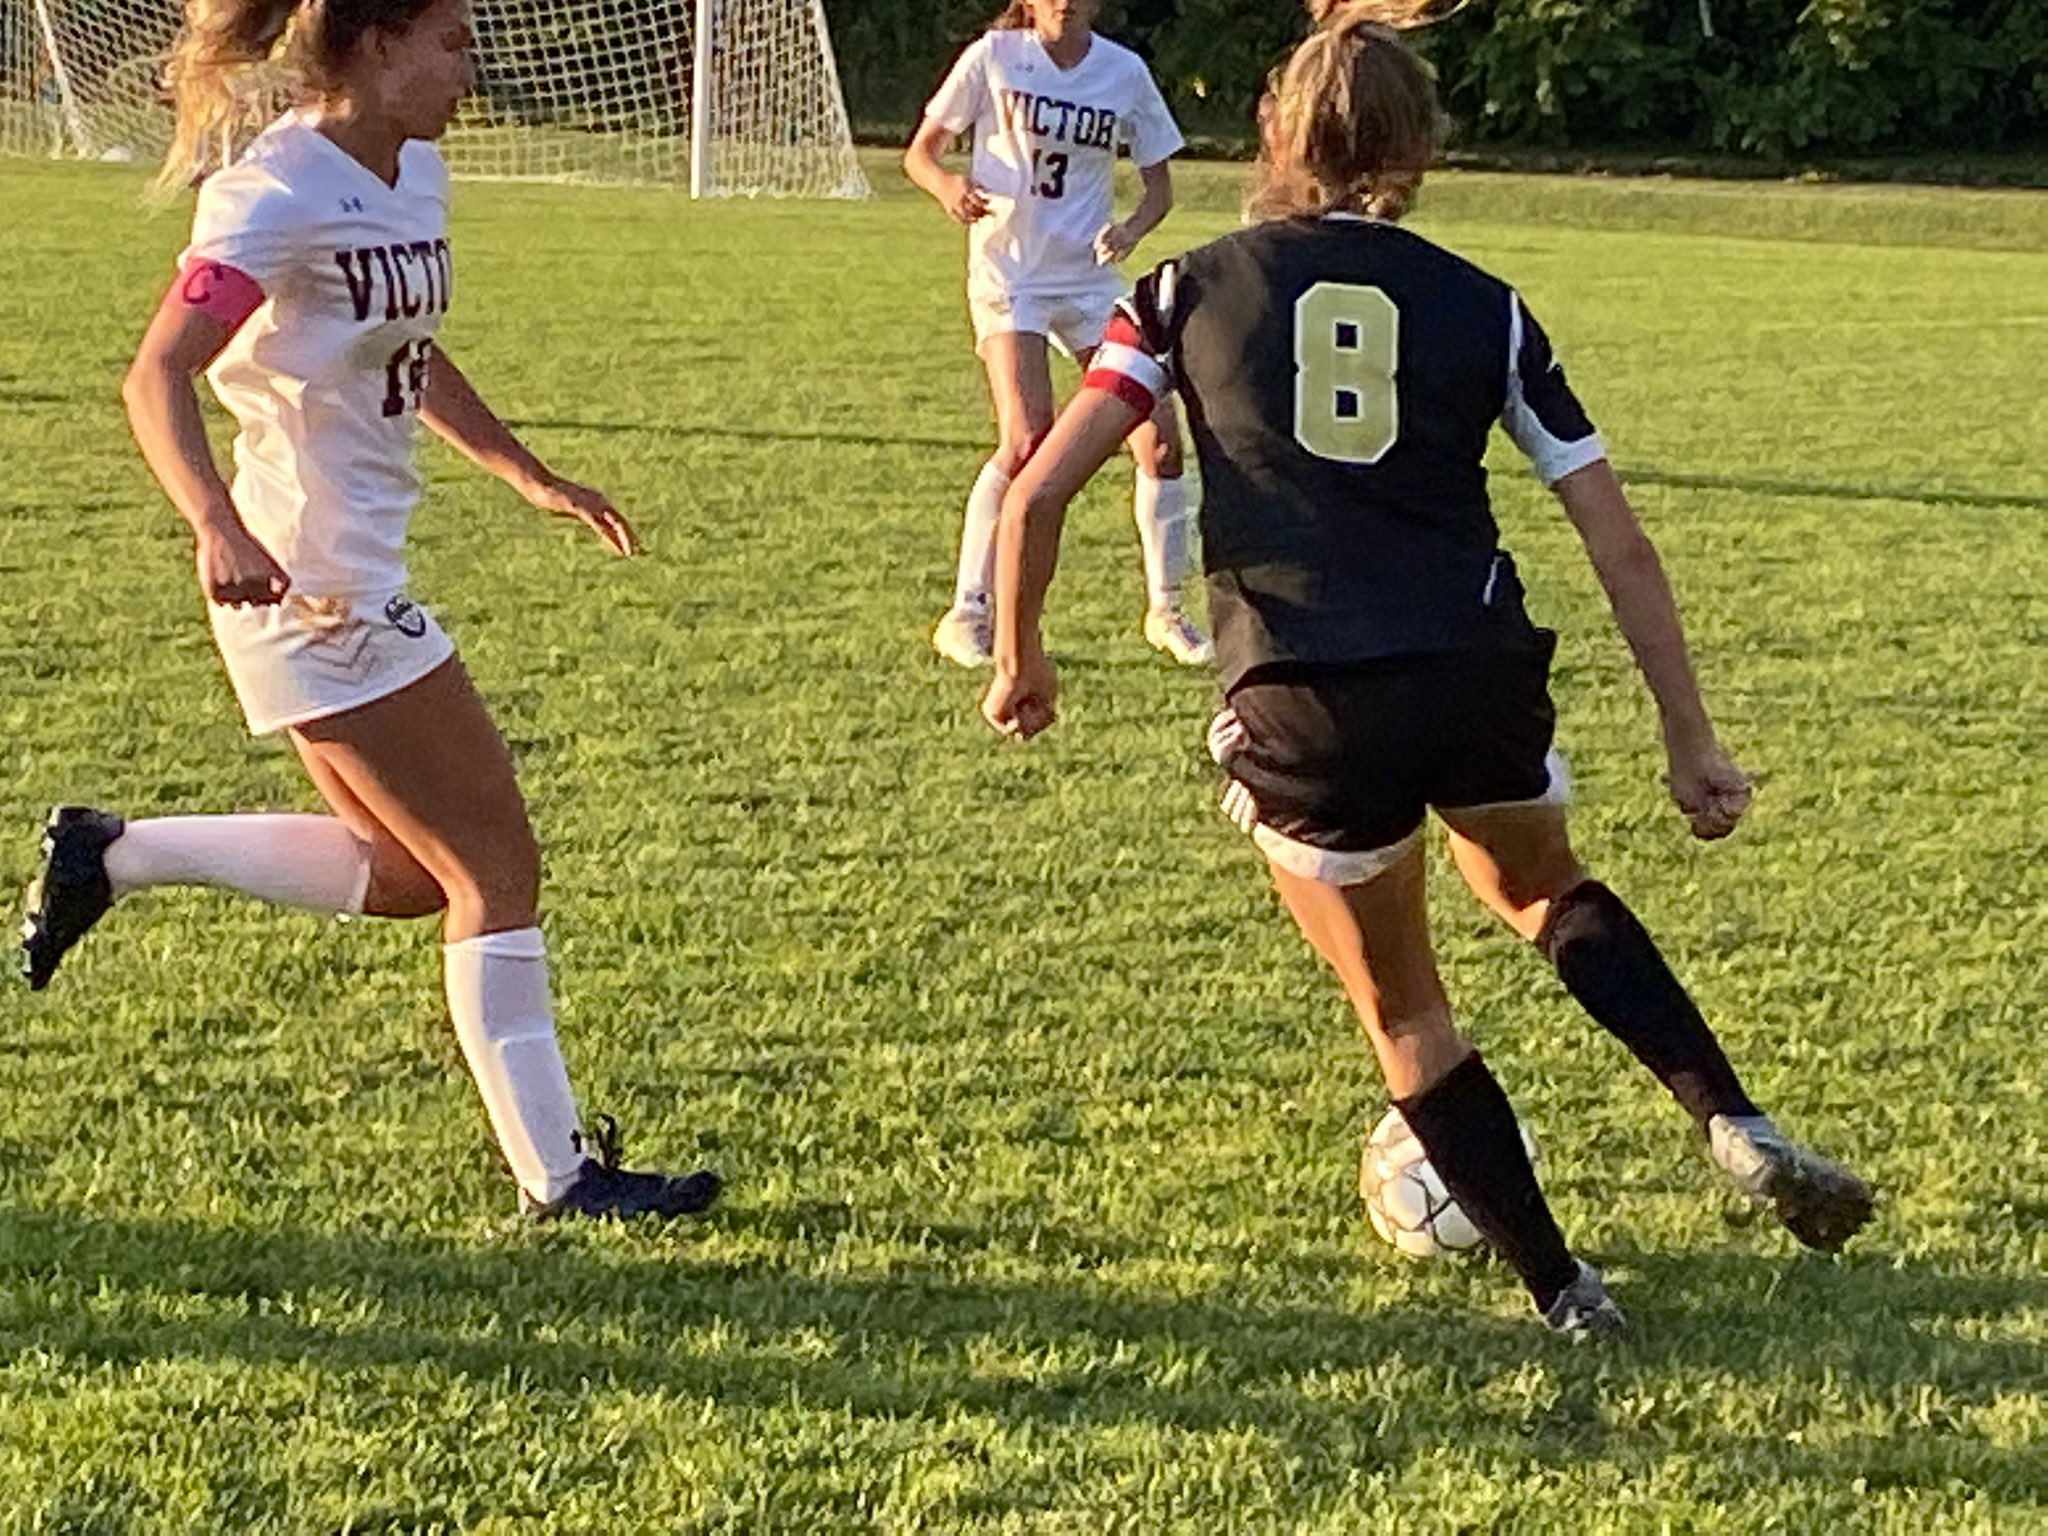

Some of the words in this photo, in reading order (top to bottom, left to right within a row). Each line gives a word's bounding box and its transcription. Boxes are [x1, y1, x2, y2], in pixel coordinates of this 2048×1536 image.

[999, 88, 1116, 150] VICTOR
[1030, 149, 1068, 199] 13
[1294, 280, 1400, 464] 8
